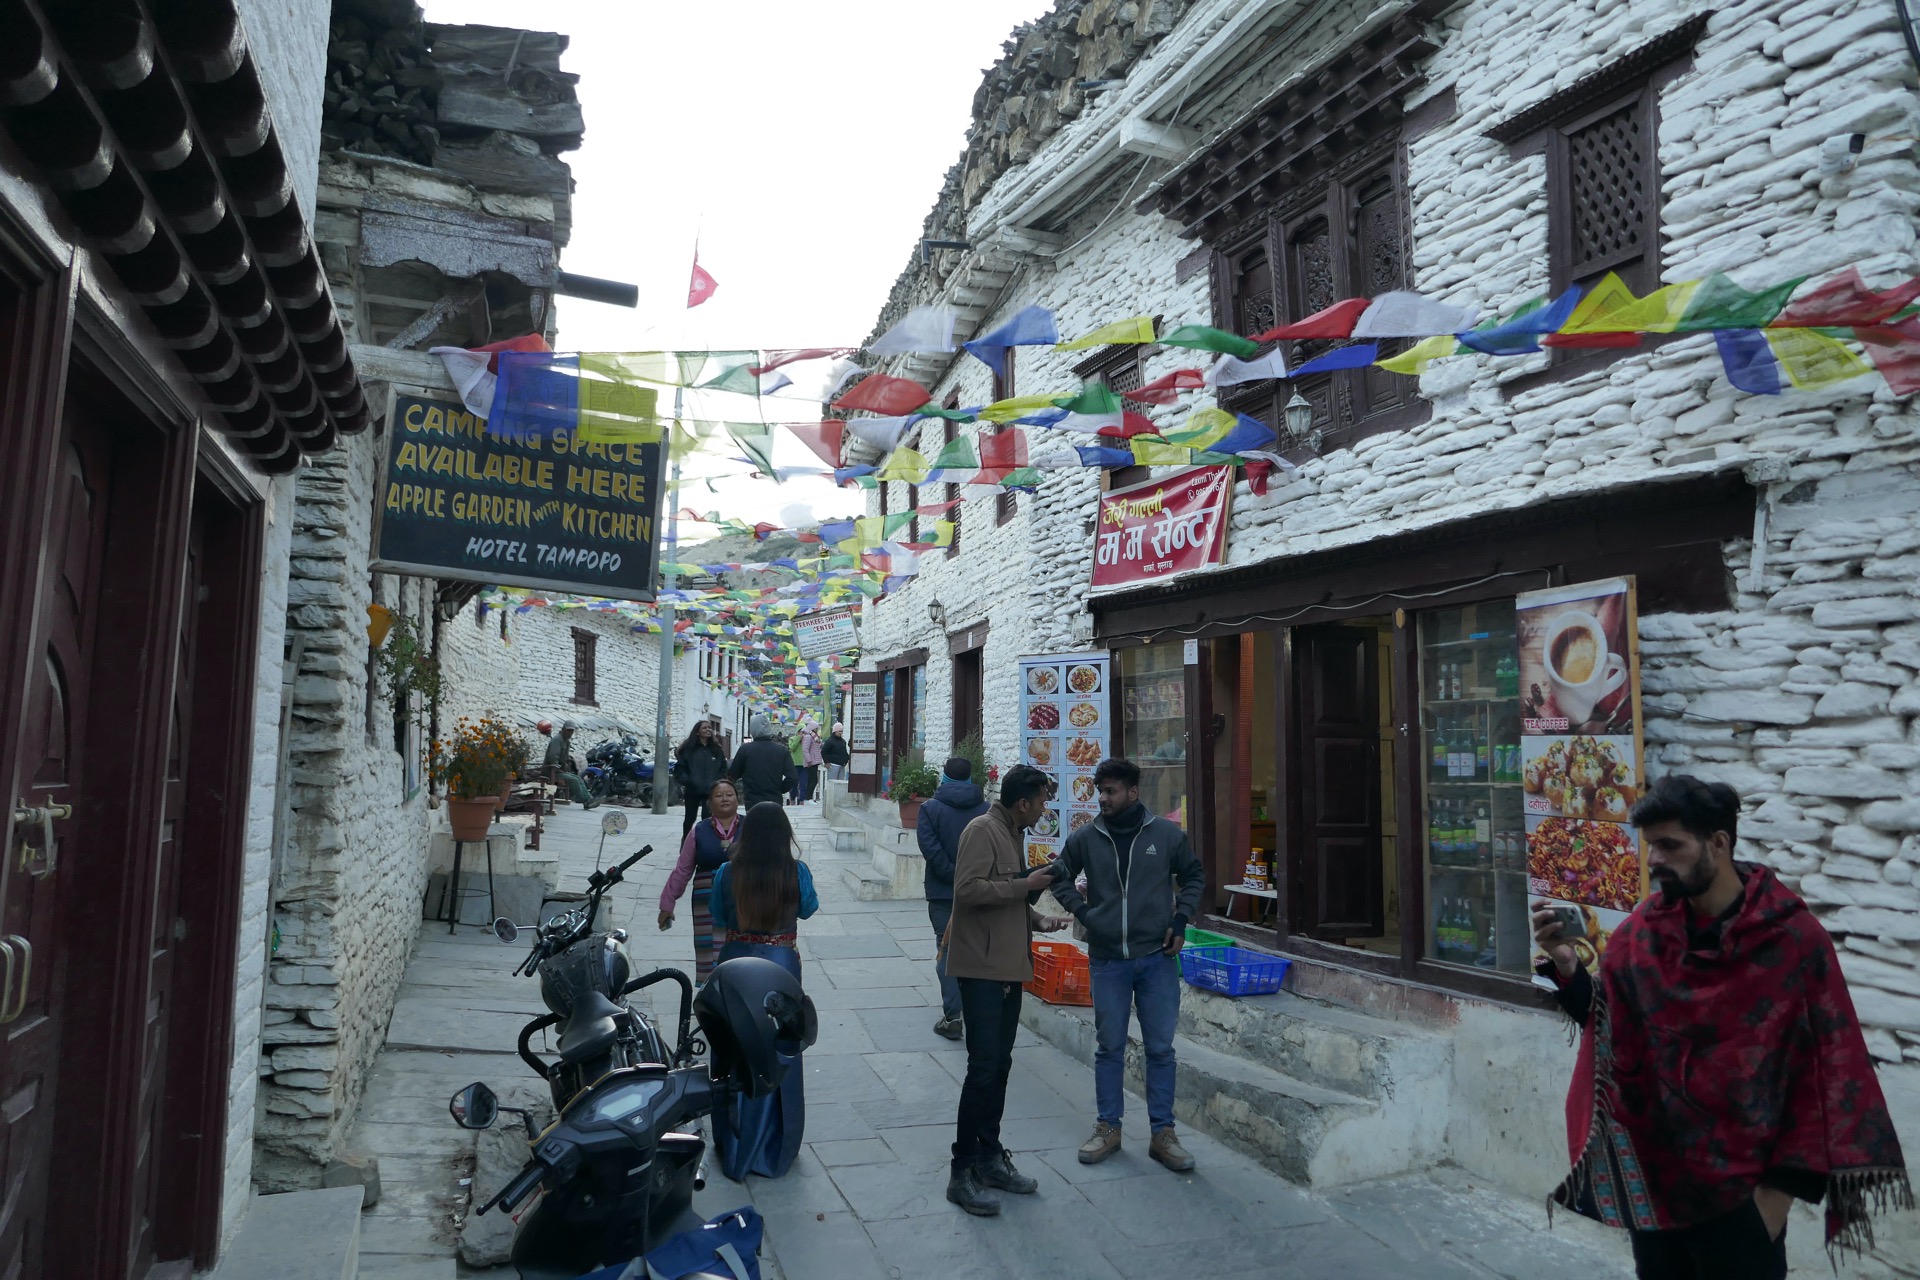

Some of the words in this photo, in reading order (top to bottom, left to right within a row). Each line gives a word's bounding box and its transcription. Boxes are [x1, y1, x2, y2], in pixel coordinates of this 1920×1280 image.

[404, 403, 543, 450] CAMPING
[551, 424, 643, 466] SPACE
[395, 441, 554, 489] AVAILABLE
[566, 464, 646, 503] HERE
[386, 482, 445, 518] APPLE
[451, 492, 531, 529] GARDEN
[532, 499, 560, 522] WITH
[562, 502, 651, 544] KITCHEN
[1151, 504, 1220, 559] सेन्टर
[465, 536, 528, 564] HOTEL
[536, 544, 622, 573] TAMPOPO
